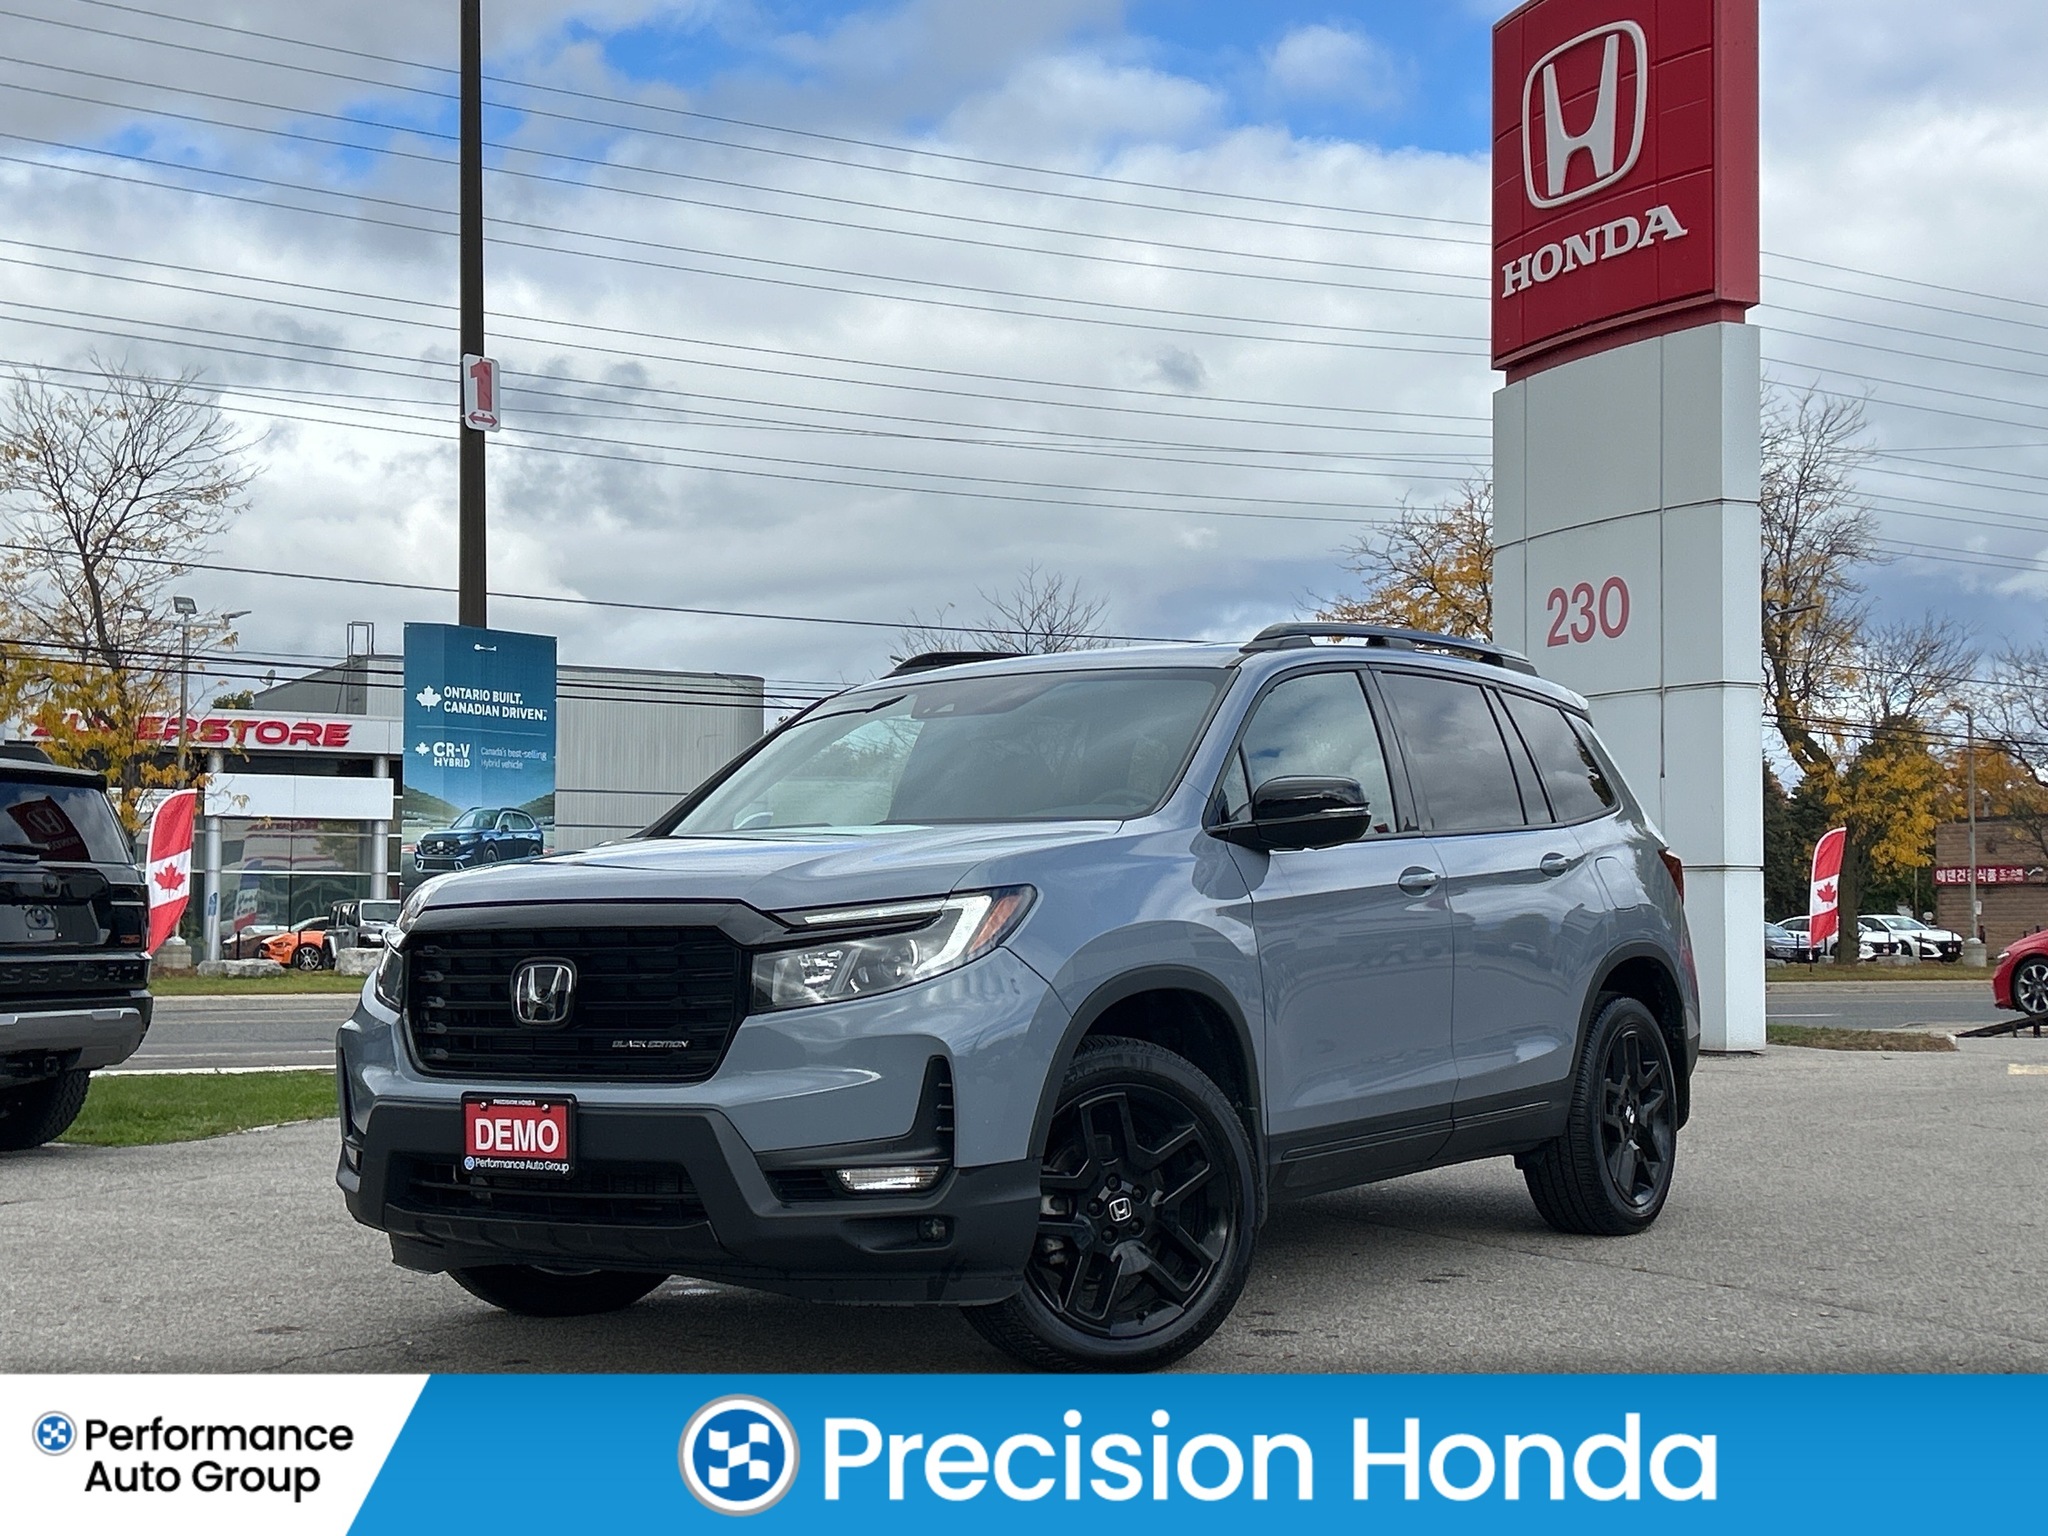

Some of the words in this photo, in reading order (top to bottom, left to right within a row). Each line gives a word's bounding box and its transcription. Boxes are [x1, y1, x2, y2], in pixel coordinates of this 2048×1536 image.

[1502, 205, 1689, 299] HONDA
[470, 360, 493, 412] 1
[1546, 576, 1630, 648] 230
[444, 686, 490, 702] ONTARIO
[492, 690, 523, 705] BUILT.
[444, 701, 500, 717] CANADIAN
[433, 742, 470, 758] CR-V
[434, 757, 470, 768] HYBRID
[612, 1040, 647, 1048] BLACK
[475, 1118, 560, 1153] DEMO
[475, 1158, 525, 1170] Performance
[526, 1160, 545, 1171] Auto
[545, 1162, 570, 1175] Group
